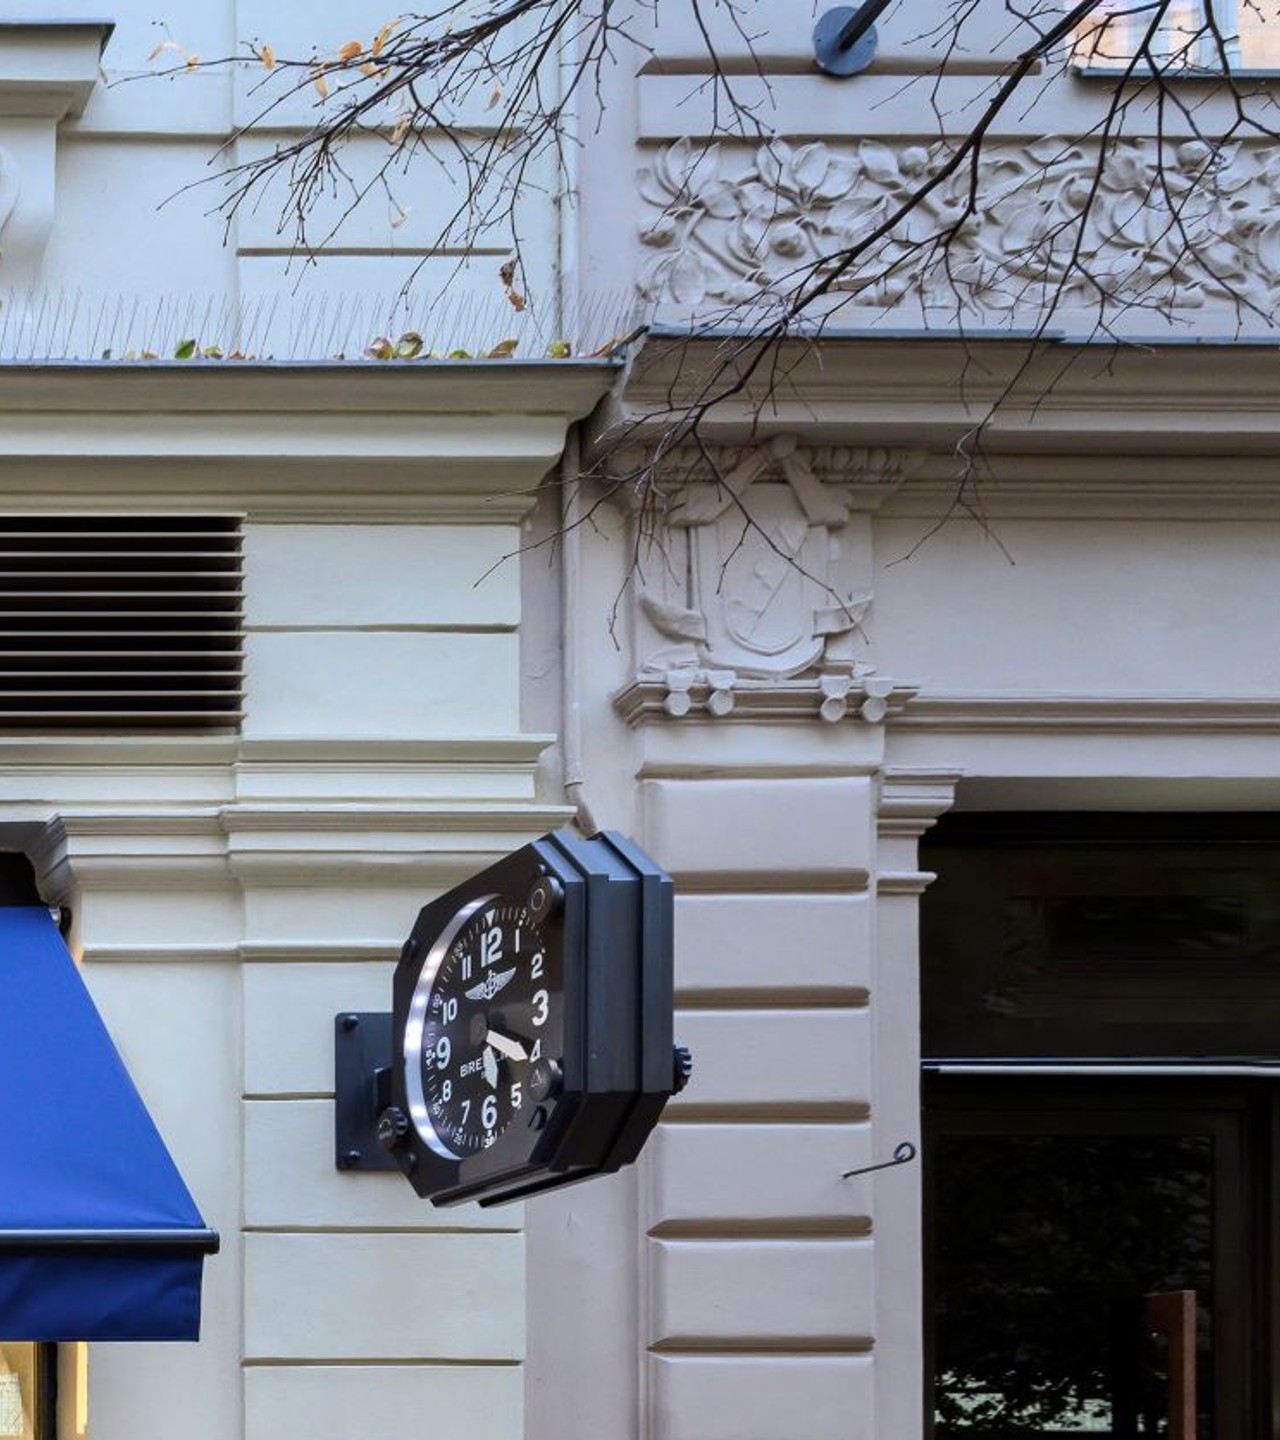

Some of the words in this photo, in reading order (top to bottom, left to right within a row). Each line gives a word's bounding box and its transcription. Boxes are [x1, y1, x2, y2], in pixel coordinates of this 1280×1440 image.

[481, 926, 503, 968] 12
[462, 954, 472, 981] 11
[530, 953, 544, 980] 2
[442, 997, 458, 1026] 10
[531, 988, 550, 1027] 3
[436, 1035, 452, 1070] 9
[529, 1038, 541, 1063] 4
[442, 1079, 452, 1102] 8
[510, 1081, 523, 1108] 5
[461, 1100, 471, 1125] 7
[481, 1094, 498, 1129] 6
